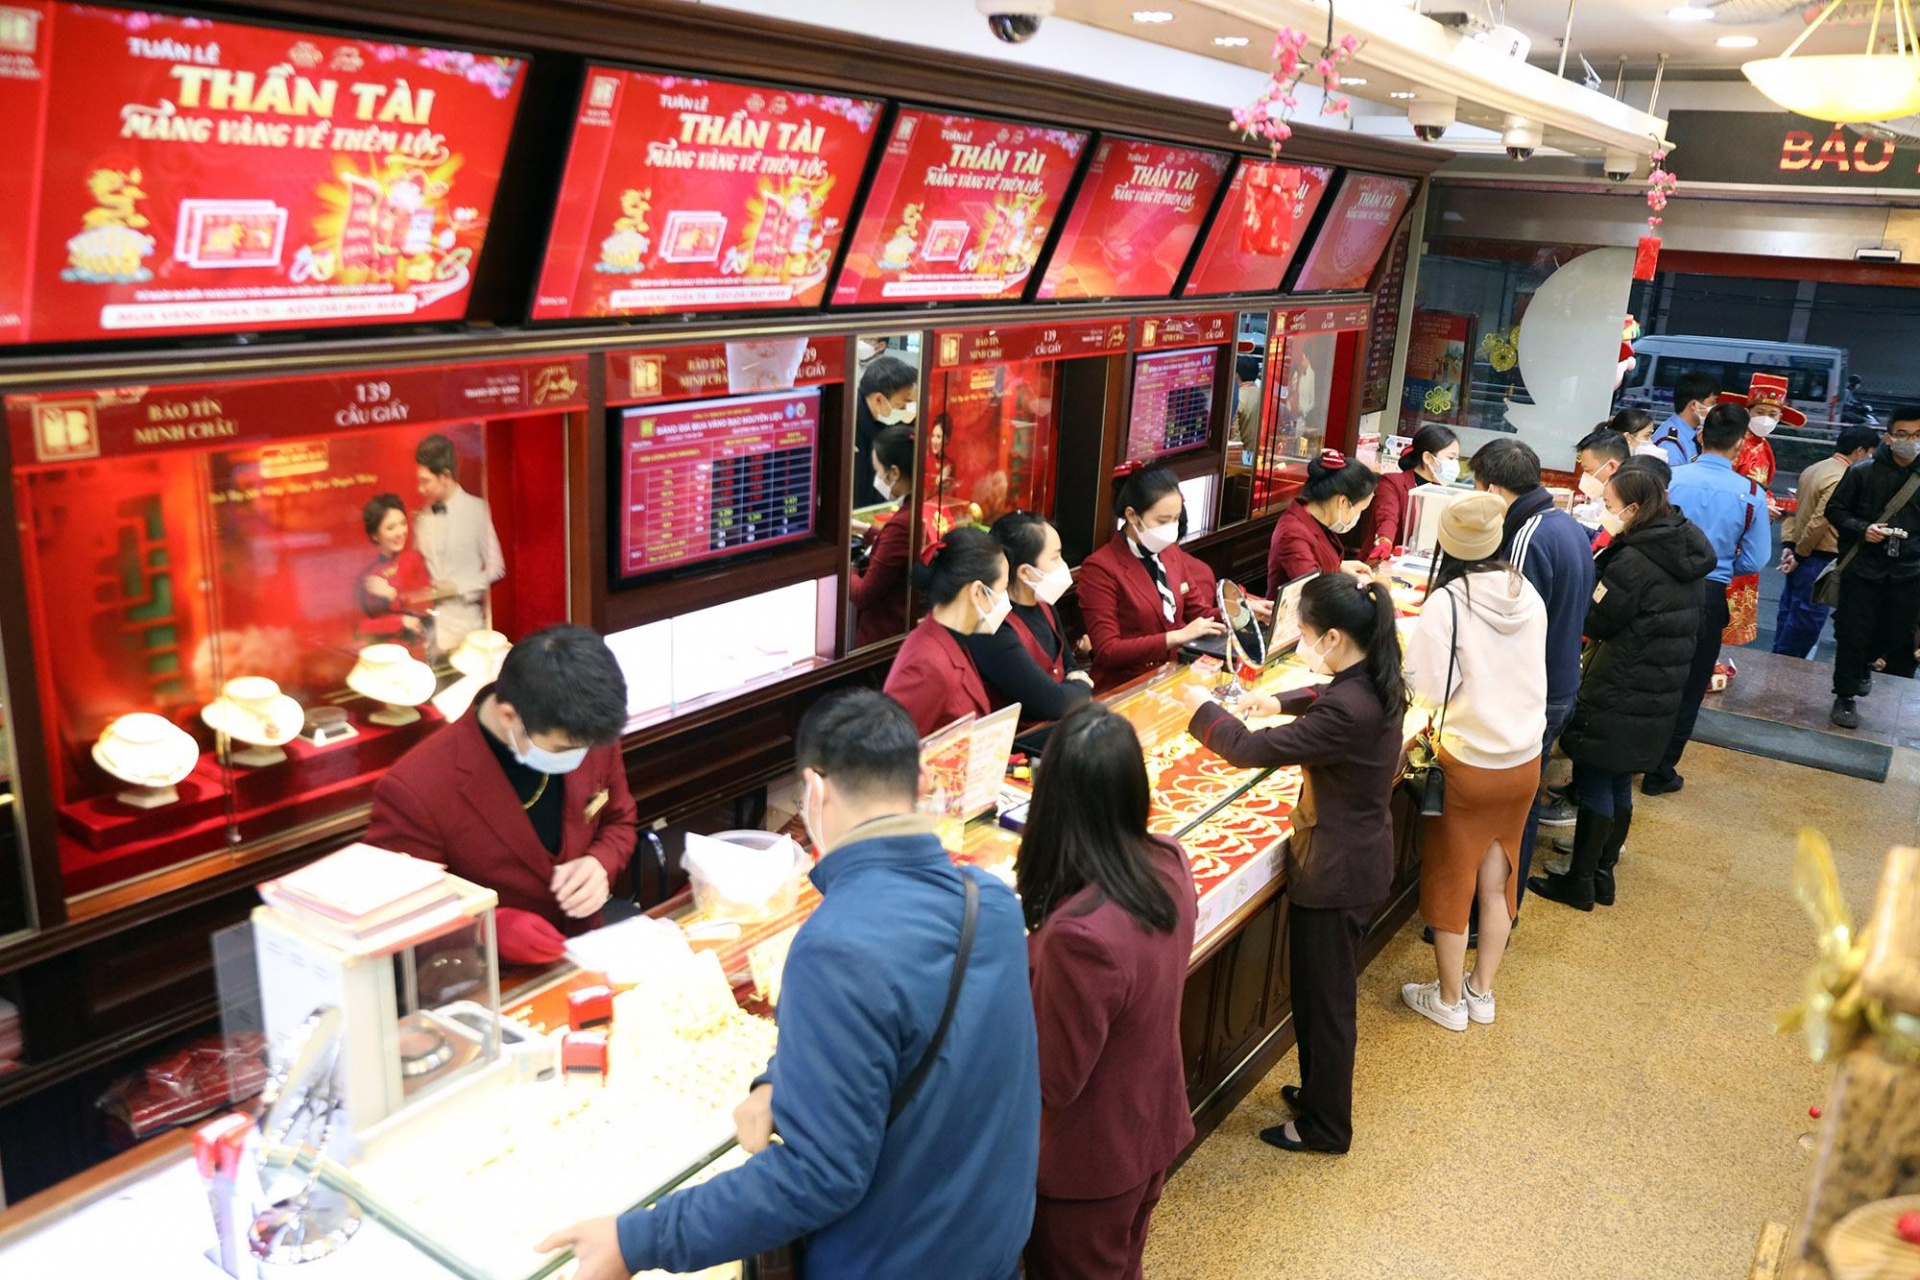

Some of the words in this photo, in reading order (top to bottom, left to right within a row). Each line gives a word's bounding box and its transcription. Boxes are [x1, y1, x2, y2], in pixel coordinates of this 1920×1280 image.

[169, 62, 339, 118] THẦN
[351, 77, 437, 125] TÀI
[218, 114, 292, 147] VÀNG
[294, 119, 332, 149] VỀ
[331, 124, 398, 152] THÊM
[393, 128, 450, 164] LỘC
[678, 108, 772, 150] THẦN
[777, 118, 827, 155] TÀI
[697, 148, 739, 172] VÀNG
[739, 150, 763, 174] VỀ
[760, 154, 801, 177] THÊM
[950, 140, 1010, 172] THẦN
[1012, 147, 1046, 175] TÀI
[957, 170, 986, 188] VÀNG
[1130, 162, 1174, 188] THẦN
[1174, 167, 1200, 190] TÀI
[1043, 329, 1057, 342] 139
[688, 355, 710, 372] BẢO
[804, 361, 828, 378] GIẤY
[355, 382, 392, 404] 139
[679, 373, 708, 388] MINH
[147, 401, 189, 422] BẢO
[189, 396, 222, 418] TÍN
[335, 402, 370, 426] CẦU
[370, 399, 411, 422] GIẤY
[133, 423, 187, 445] MINH
[186, 416, 239, 440] CHÂU
